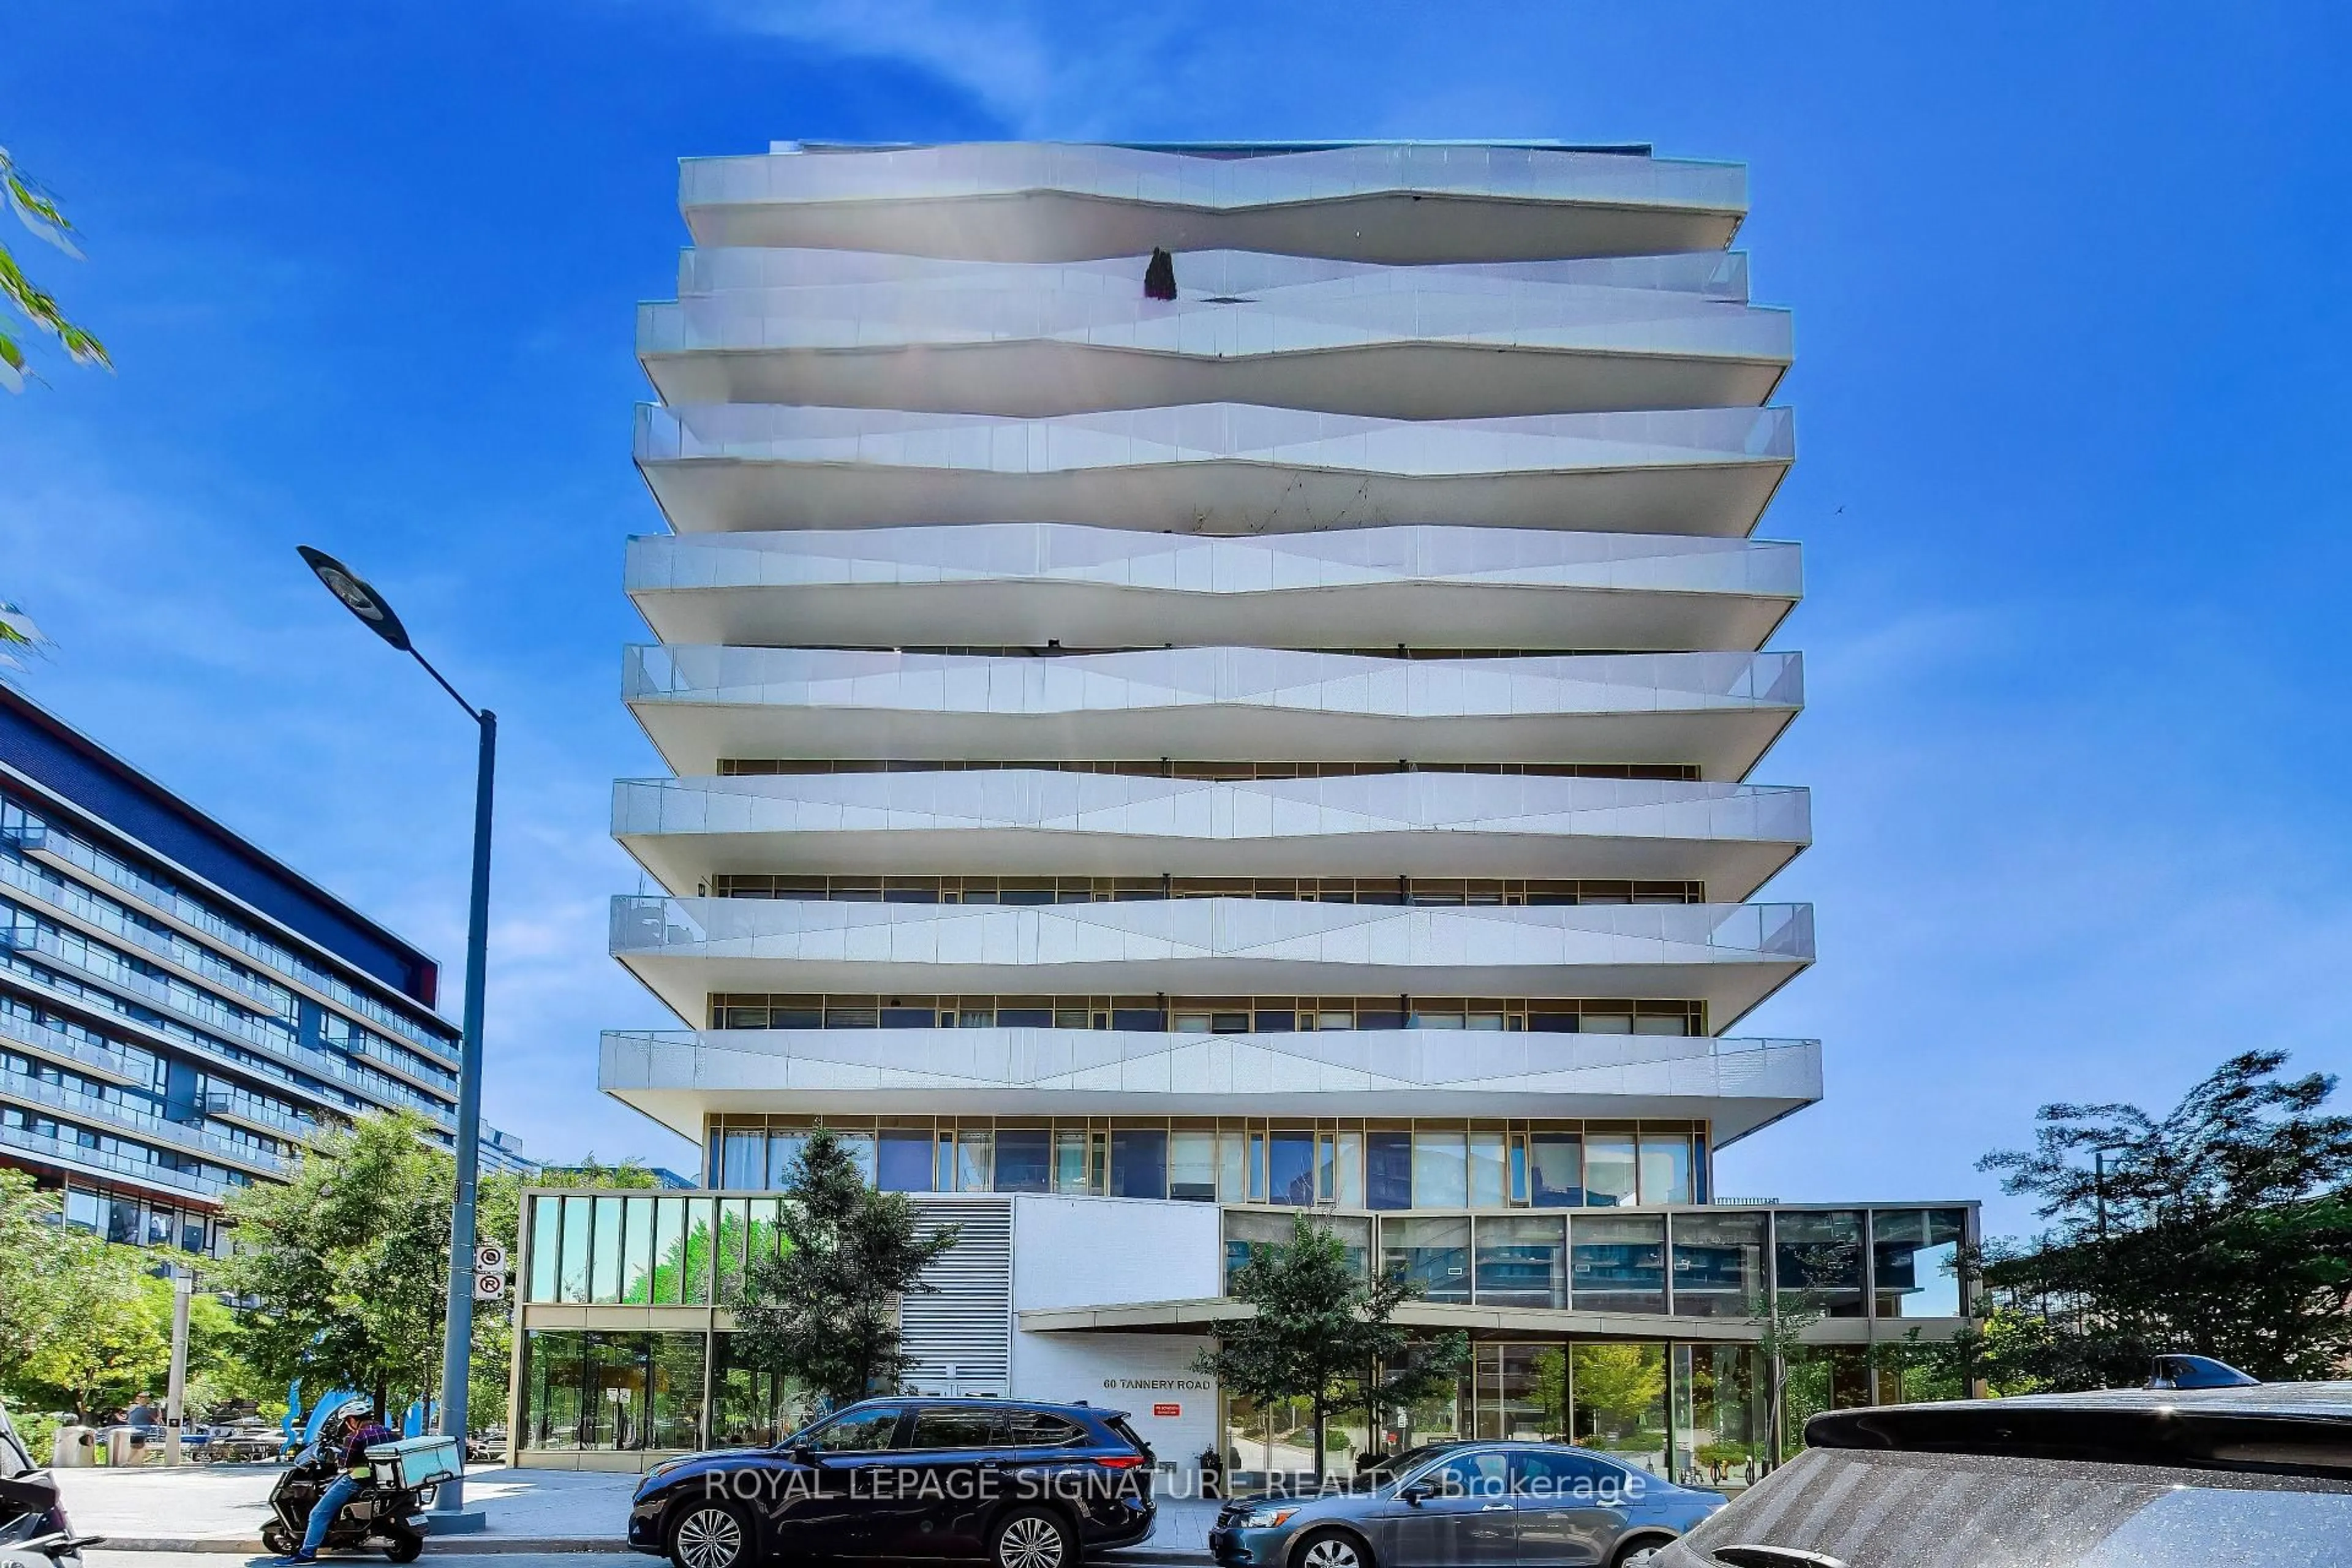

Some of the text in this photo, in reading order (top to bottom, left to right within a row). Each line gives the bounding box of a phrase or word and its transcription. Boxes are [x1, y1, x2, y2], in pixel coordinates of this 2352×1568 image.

[485, 1280, 496, 1289] P
[1104, 1379, 1210, 1390] 60 TANNERY ROAD
